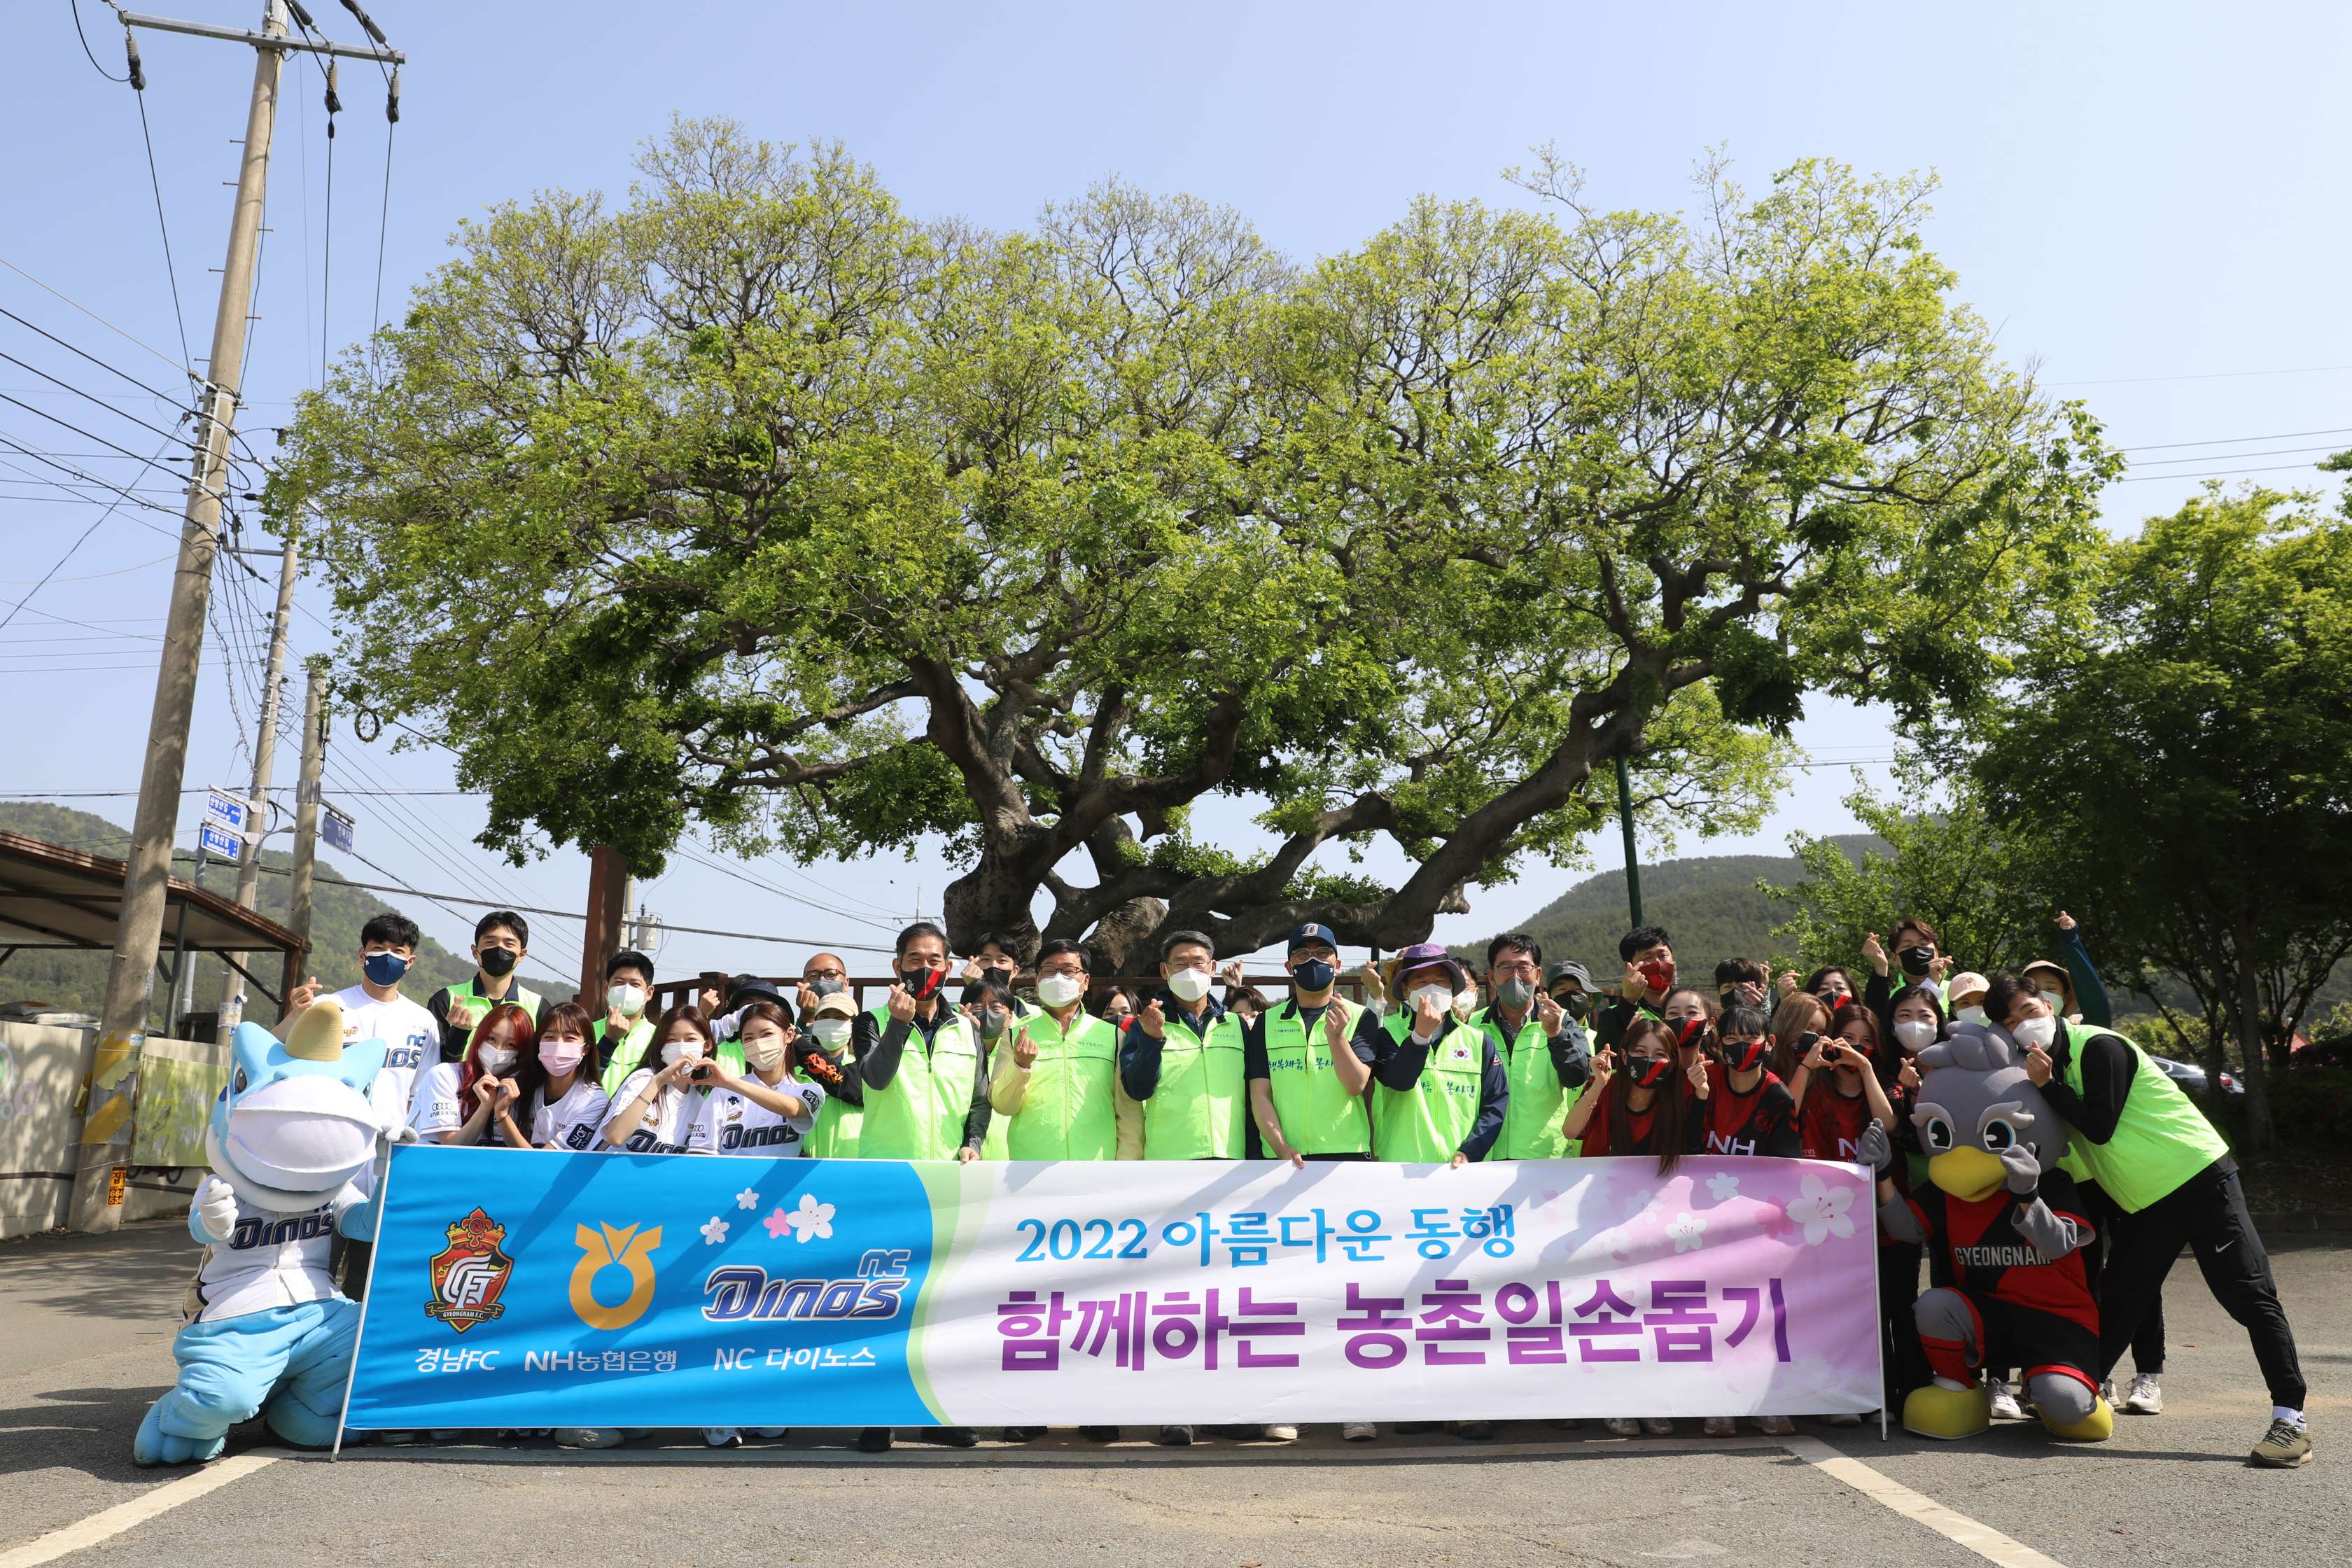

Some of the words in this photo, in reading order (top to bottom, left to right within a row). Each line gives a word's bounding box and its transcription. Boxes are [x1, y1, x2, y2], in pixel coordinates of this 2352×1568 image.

[1446, 1082, 1476, 1098] 봉사단
[1706, 1130, 1756, 1156] NH
[1837, 1138, 1861, 1157] N
[1014, 1218, 1148, 1262] 2022
[1162, 1208, 1392, 1268] 아름다운
[1404, 1204, 1516, 1260] 동행
[997, 1286, 1306, 1372] 함께하는
[1336, 1278, 1792, 1370] 농촌일손돕기
[414, 1348, 500, 1373] 경남FC
[524, 1350, 677, 1373] NH농협은행
[713, 1348, 756, 1371] NC
[764, 1347, 876, 1371] 다이노스
